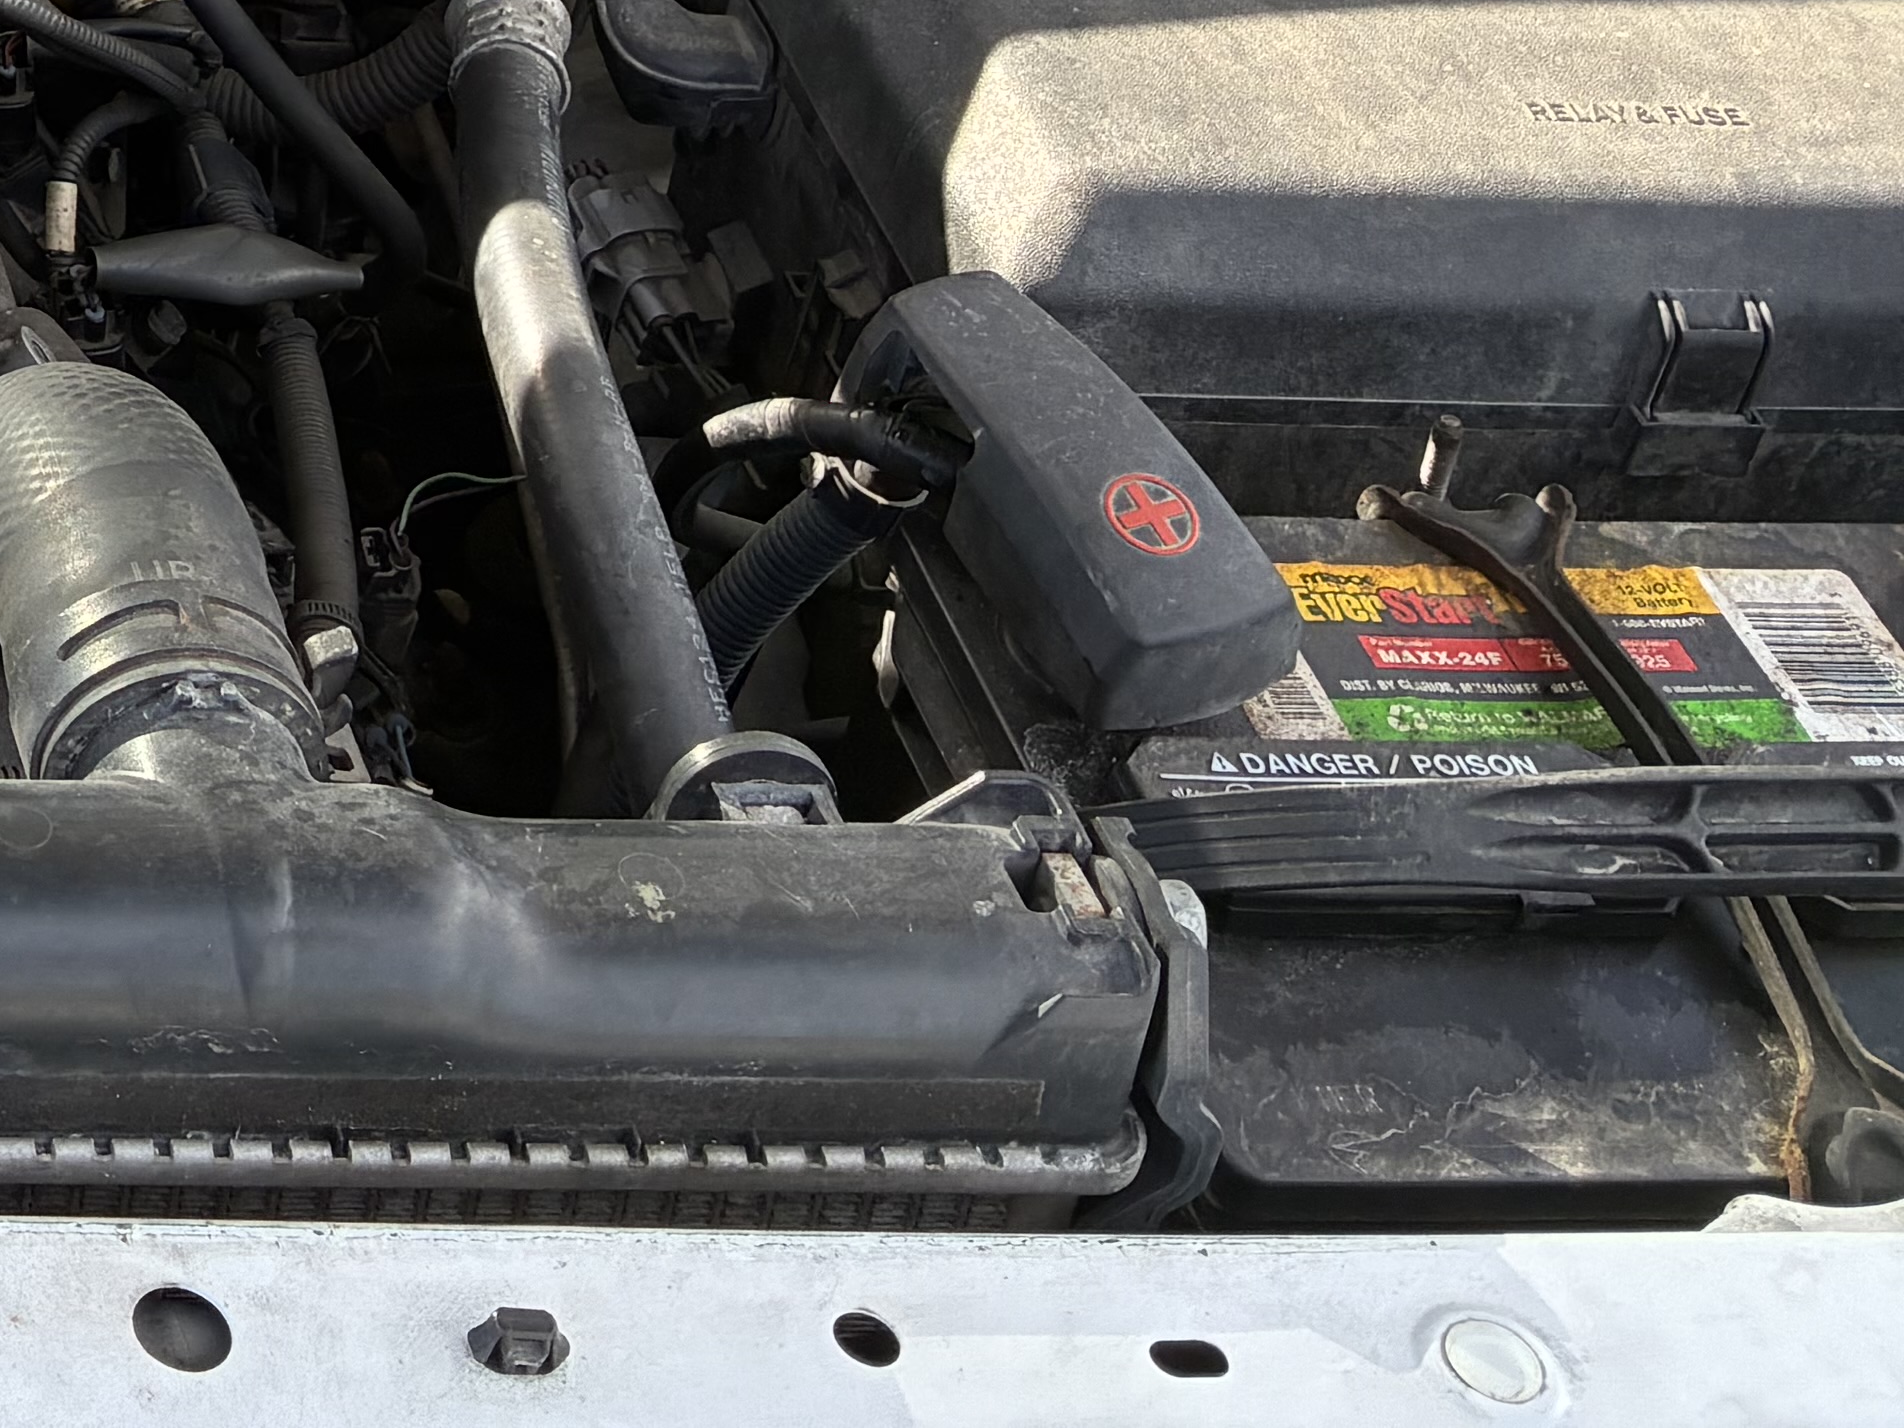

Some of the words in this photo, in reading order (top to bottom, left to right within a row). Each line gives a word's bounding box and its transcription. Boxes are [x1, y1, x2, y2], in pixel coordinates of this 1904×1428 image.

[1525, 101, 1628, 125] RELAY
[1635, 104, 1660, 125] &
[1661, 102, 1750, 127] FUSE
[1292, 585, 1501, 625] EverStart
[1377, 649, 1503, 666] MAXX-24F
[1340, 679, 1376, 692] DIST.
[1376, 680, 1396, 692] BY
[1238, 752, 1381, 776] DANGER
[1410, 753, 1540, 777] POISON
